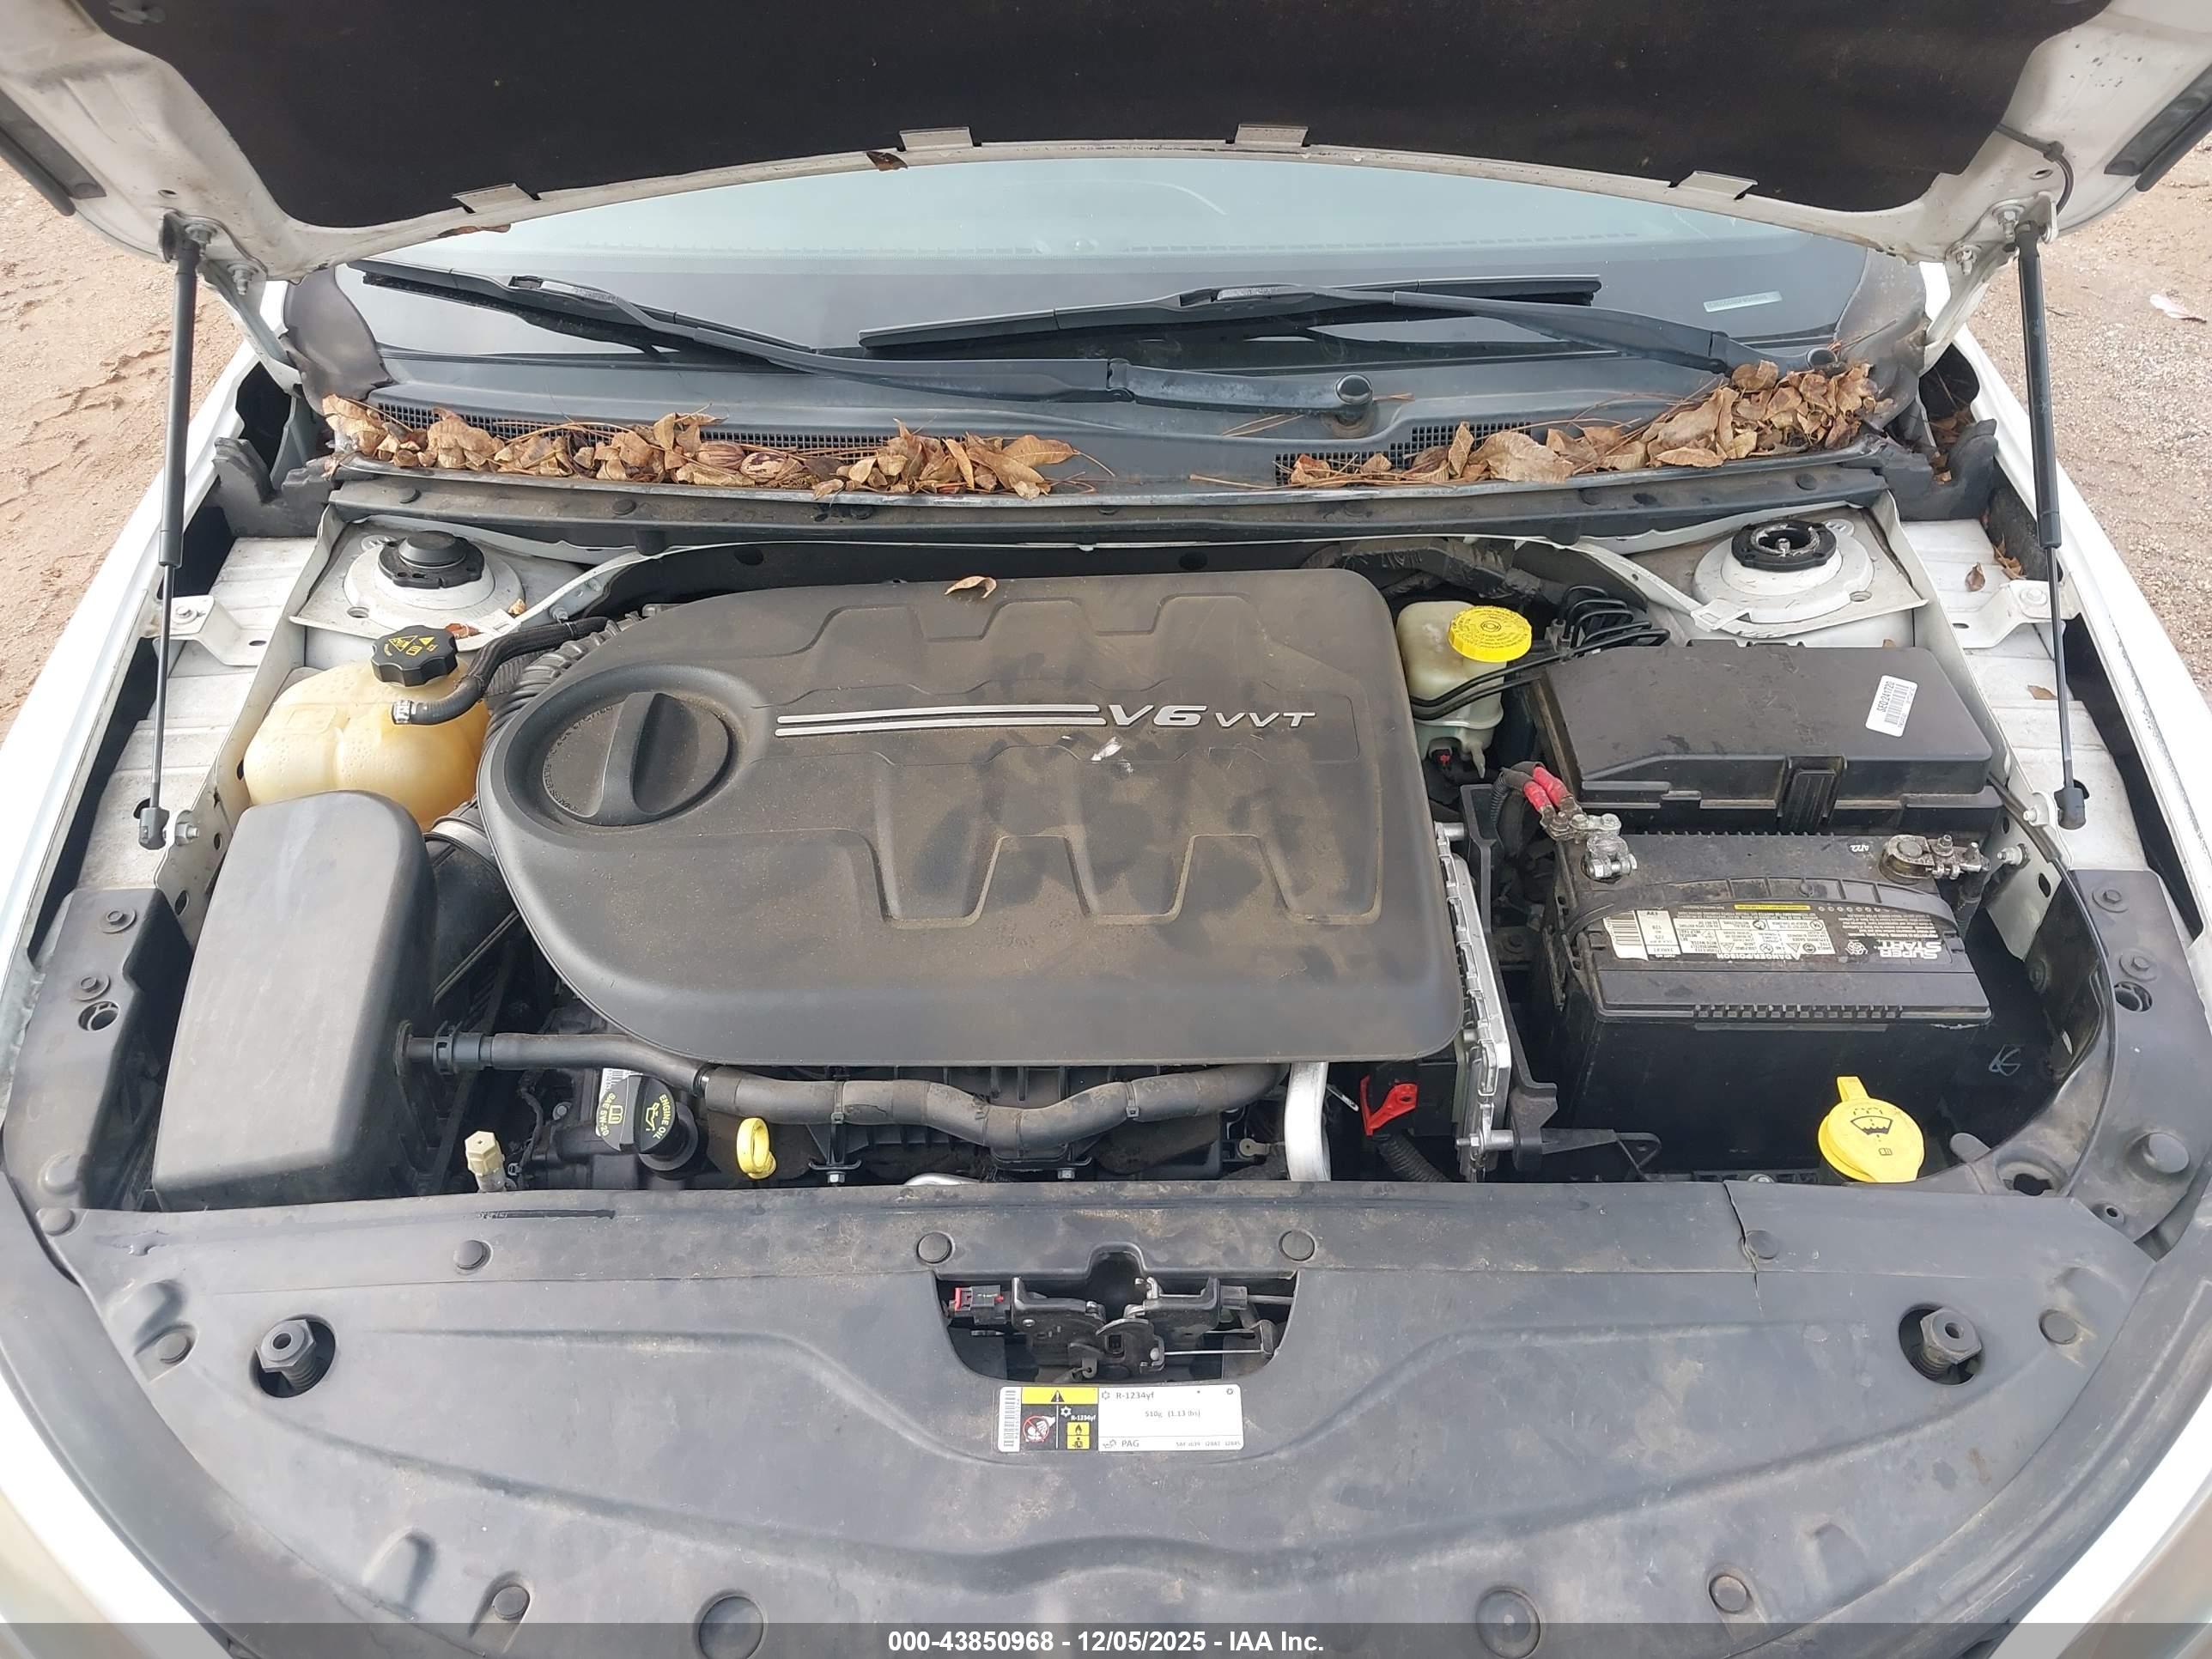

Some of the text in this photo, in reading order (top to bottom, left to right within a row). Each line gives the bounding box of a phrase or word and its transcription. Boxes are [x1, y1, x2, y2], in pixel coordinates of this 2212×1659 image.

[1108, 703, 1316, 727] V6 VVT
[1877, 941, 1942, 952] START
[1879, 949, 1938, 959] SUPER
[652, 1093, 672, 1139] ENGINE OIL
[1115, 1391, 1155, 1401] R-1234yf
[1121, 1439, 1139, 1448] PAG
